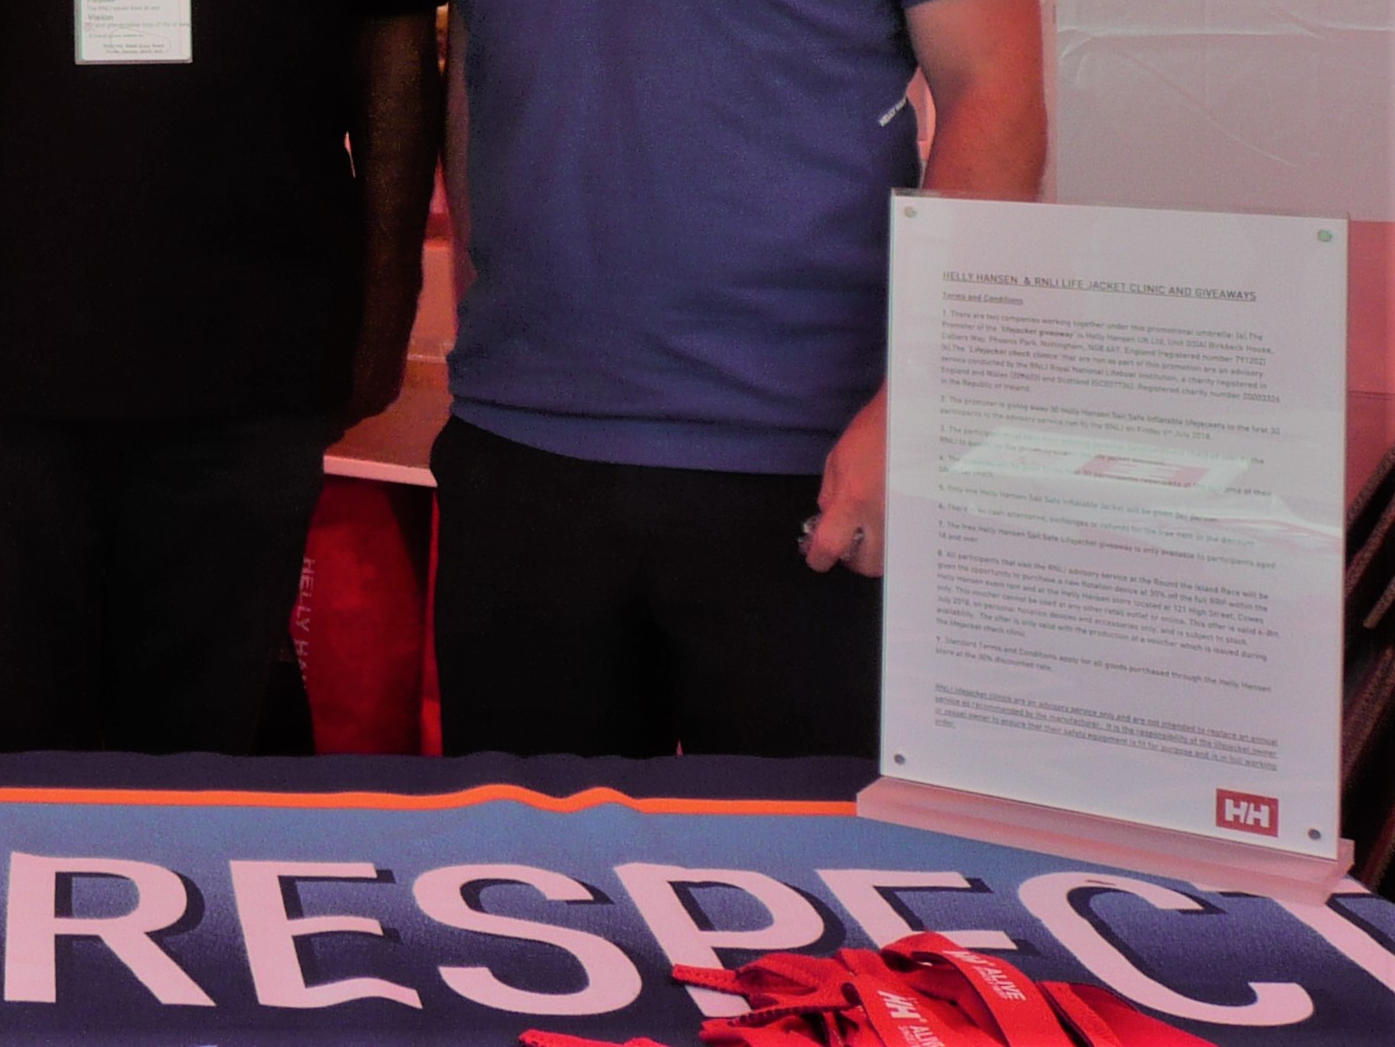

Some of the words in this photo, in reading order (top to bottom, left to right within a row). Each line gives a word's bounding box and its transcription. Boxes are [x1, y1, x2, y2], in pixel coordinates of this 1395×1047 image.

[942, 270, 973, 281] HELLY
[975, 272, 1019, 284] HANSEN
[1023, 275, 1031, 285] &
[1033, 276, 1059, 287] RNLI
[1061, 278, 1083, 288] LIFE
[1087, 279, 1125, 291] JACKET
[1128, 282, 1165, 294] CLINIC
[1168, 285, 1192, 295] AND
[1194, 286, 1256, 300] GIVEAWAYS
[1106, 332, 1134, 343] Hansen
[1222, 797, 1272, 829] HH
[983, 966, 1028, 1002] ALIVE
[877, 989, 922, 1020] HH
